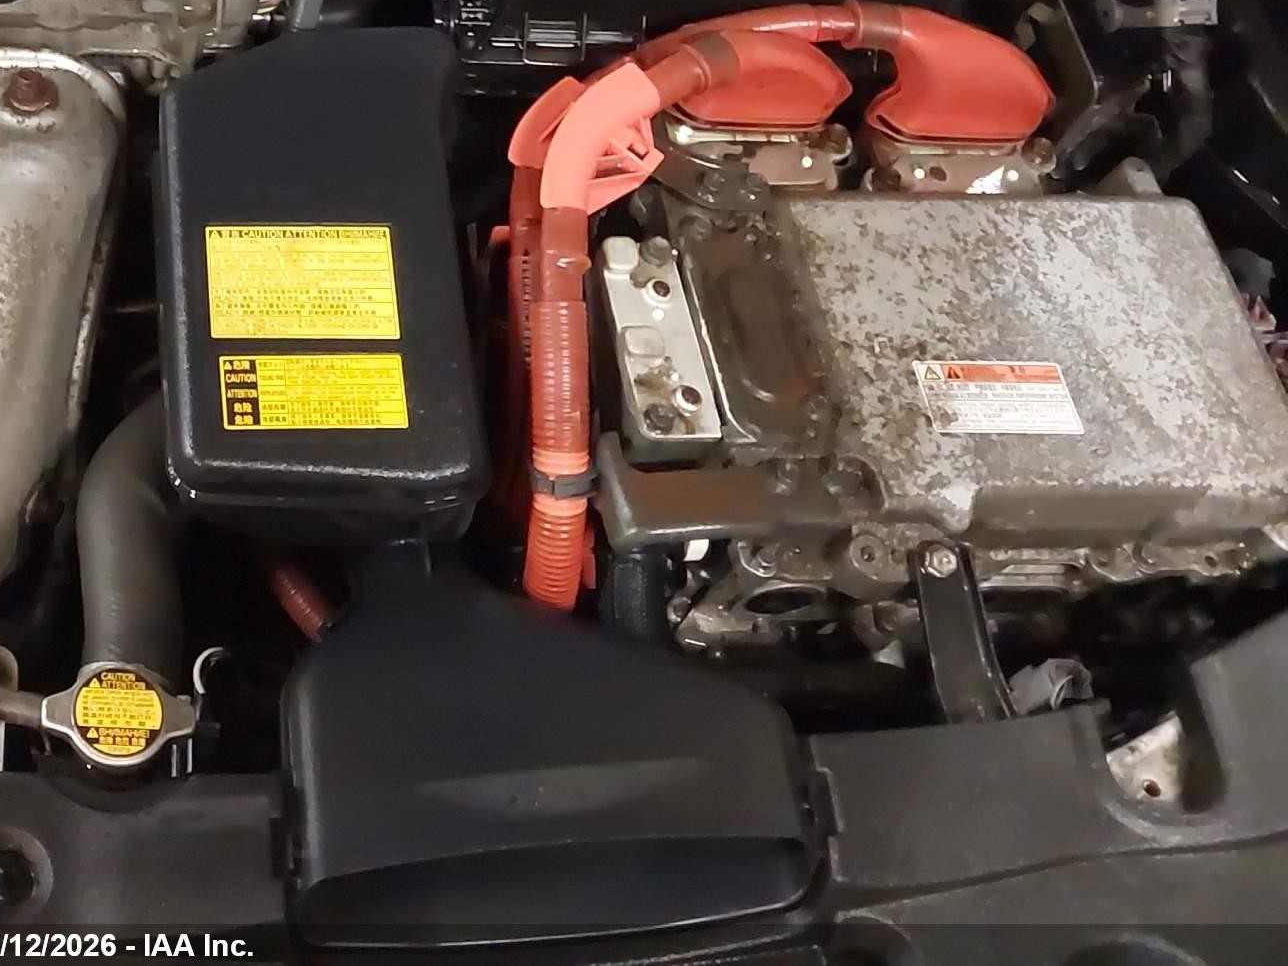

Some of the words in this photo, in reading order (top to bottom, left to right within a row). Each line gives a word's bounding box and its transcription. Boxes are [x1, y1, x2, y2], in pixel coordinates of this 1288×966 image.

[240, 230, 283, 239] CAUTION
[284, 230, 337, 239] ATTENTION
[225, 373, 257, 383] CAUTION
[227, 389, 258, 398] ATTENTION
[101, 672, 136, 682] CAUTION
[102, 682, 146, 690] ATTENTION
